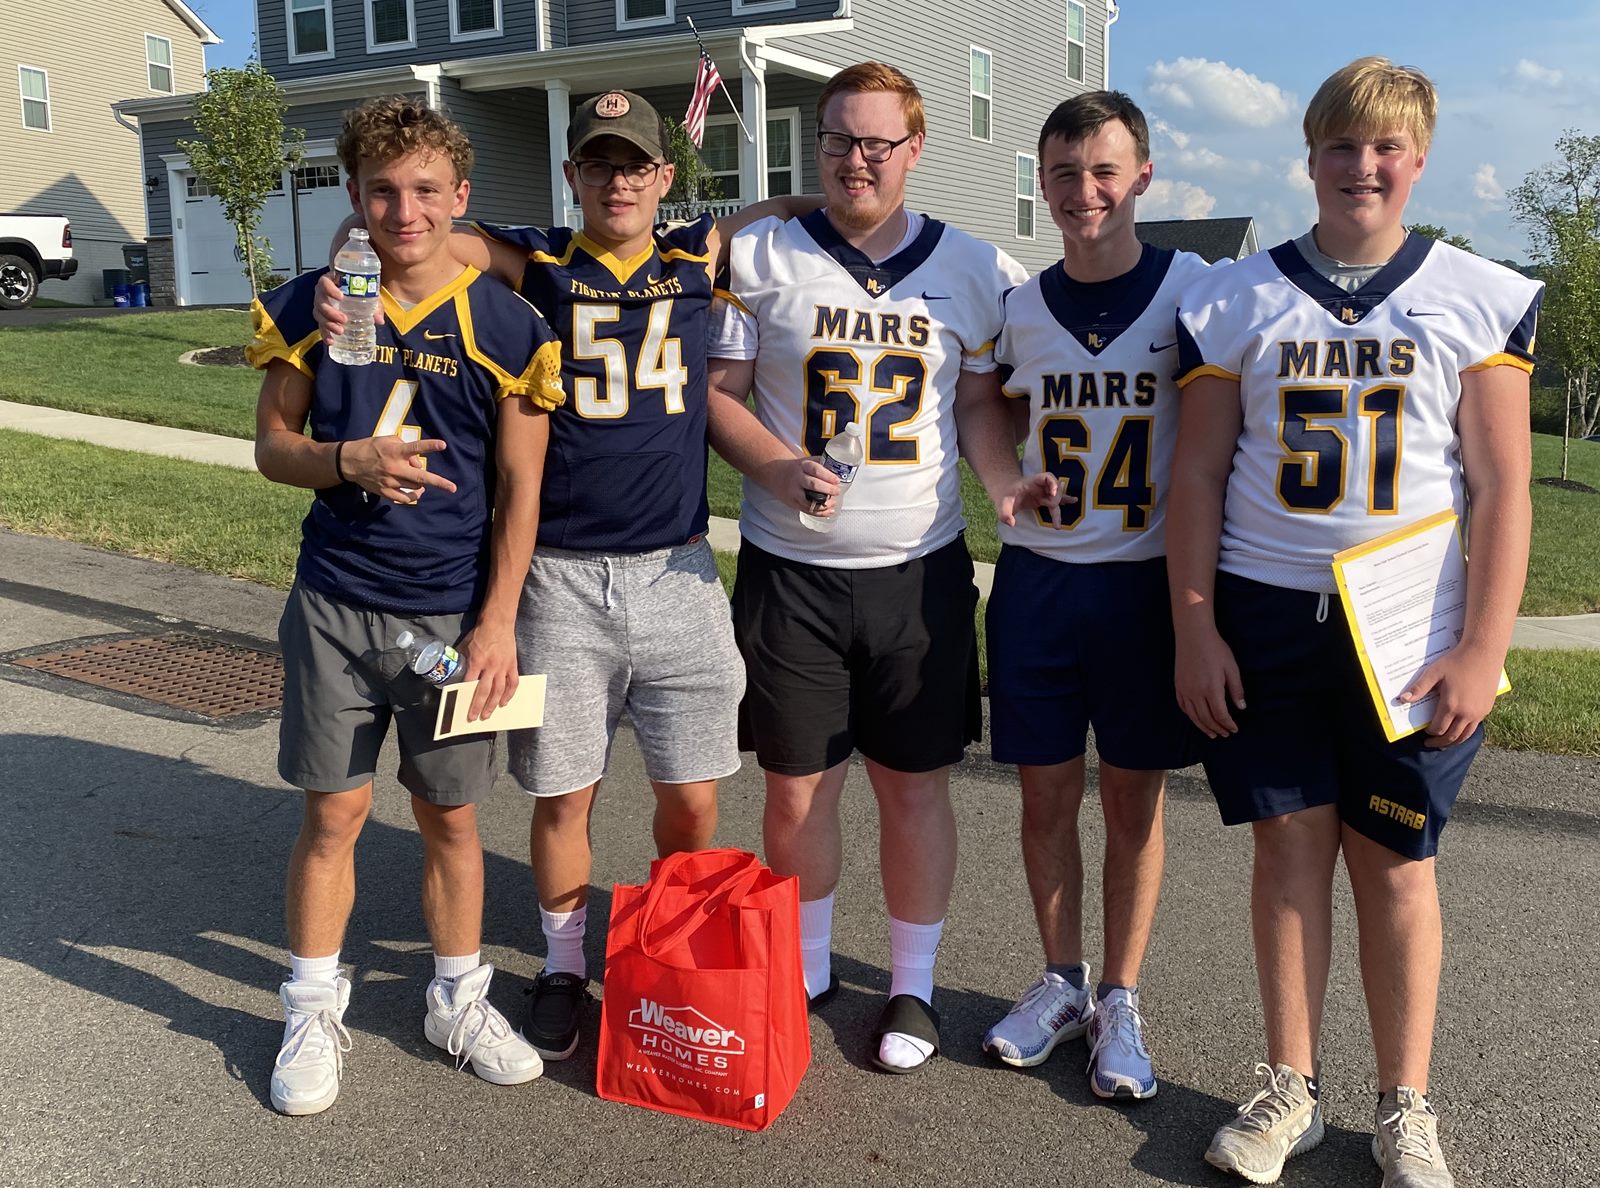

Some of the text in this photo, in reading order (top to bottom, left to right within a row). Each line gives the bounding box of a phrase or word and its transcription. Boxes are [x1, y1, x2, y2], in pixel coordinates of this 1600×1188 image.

[626, 275, 683, 299] PLANETS
[811, 304, 930, 347] MARS
[402, 348, 458, 377] PLANETS
[572, 298, 688, 419] 54
[1276, 337, 1416, 380] MARS
[803, 347, 928, 465] 62
[1041, 371, 1158, 410] MARS
[1275, 383, 1406, 516] 51
[1035, 415, 1157, 532] 64
[640, 998, 735, 1048] Weaver
[642, 1033, 729, 1069] HOMES
[626, 1062, 740, 1096] WEAVERHOMES.COM
